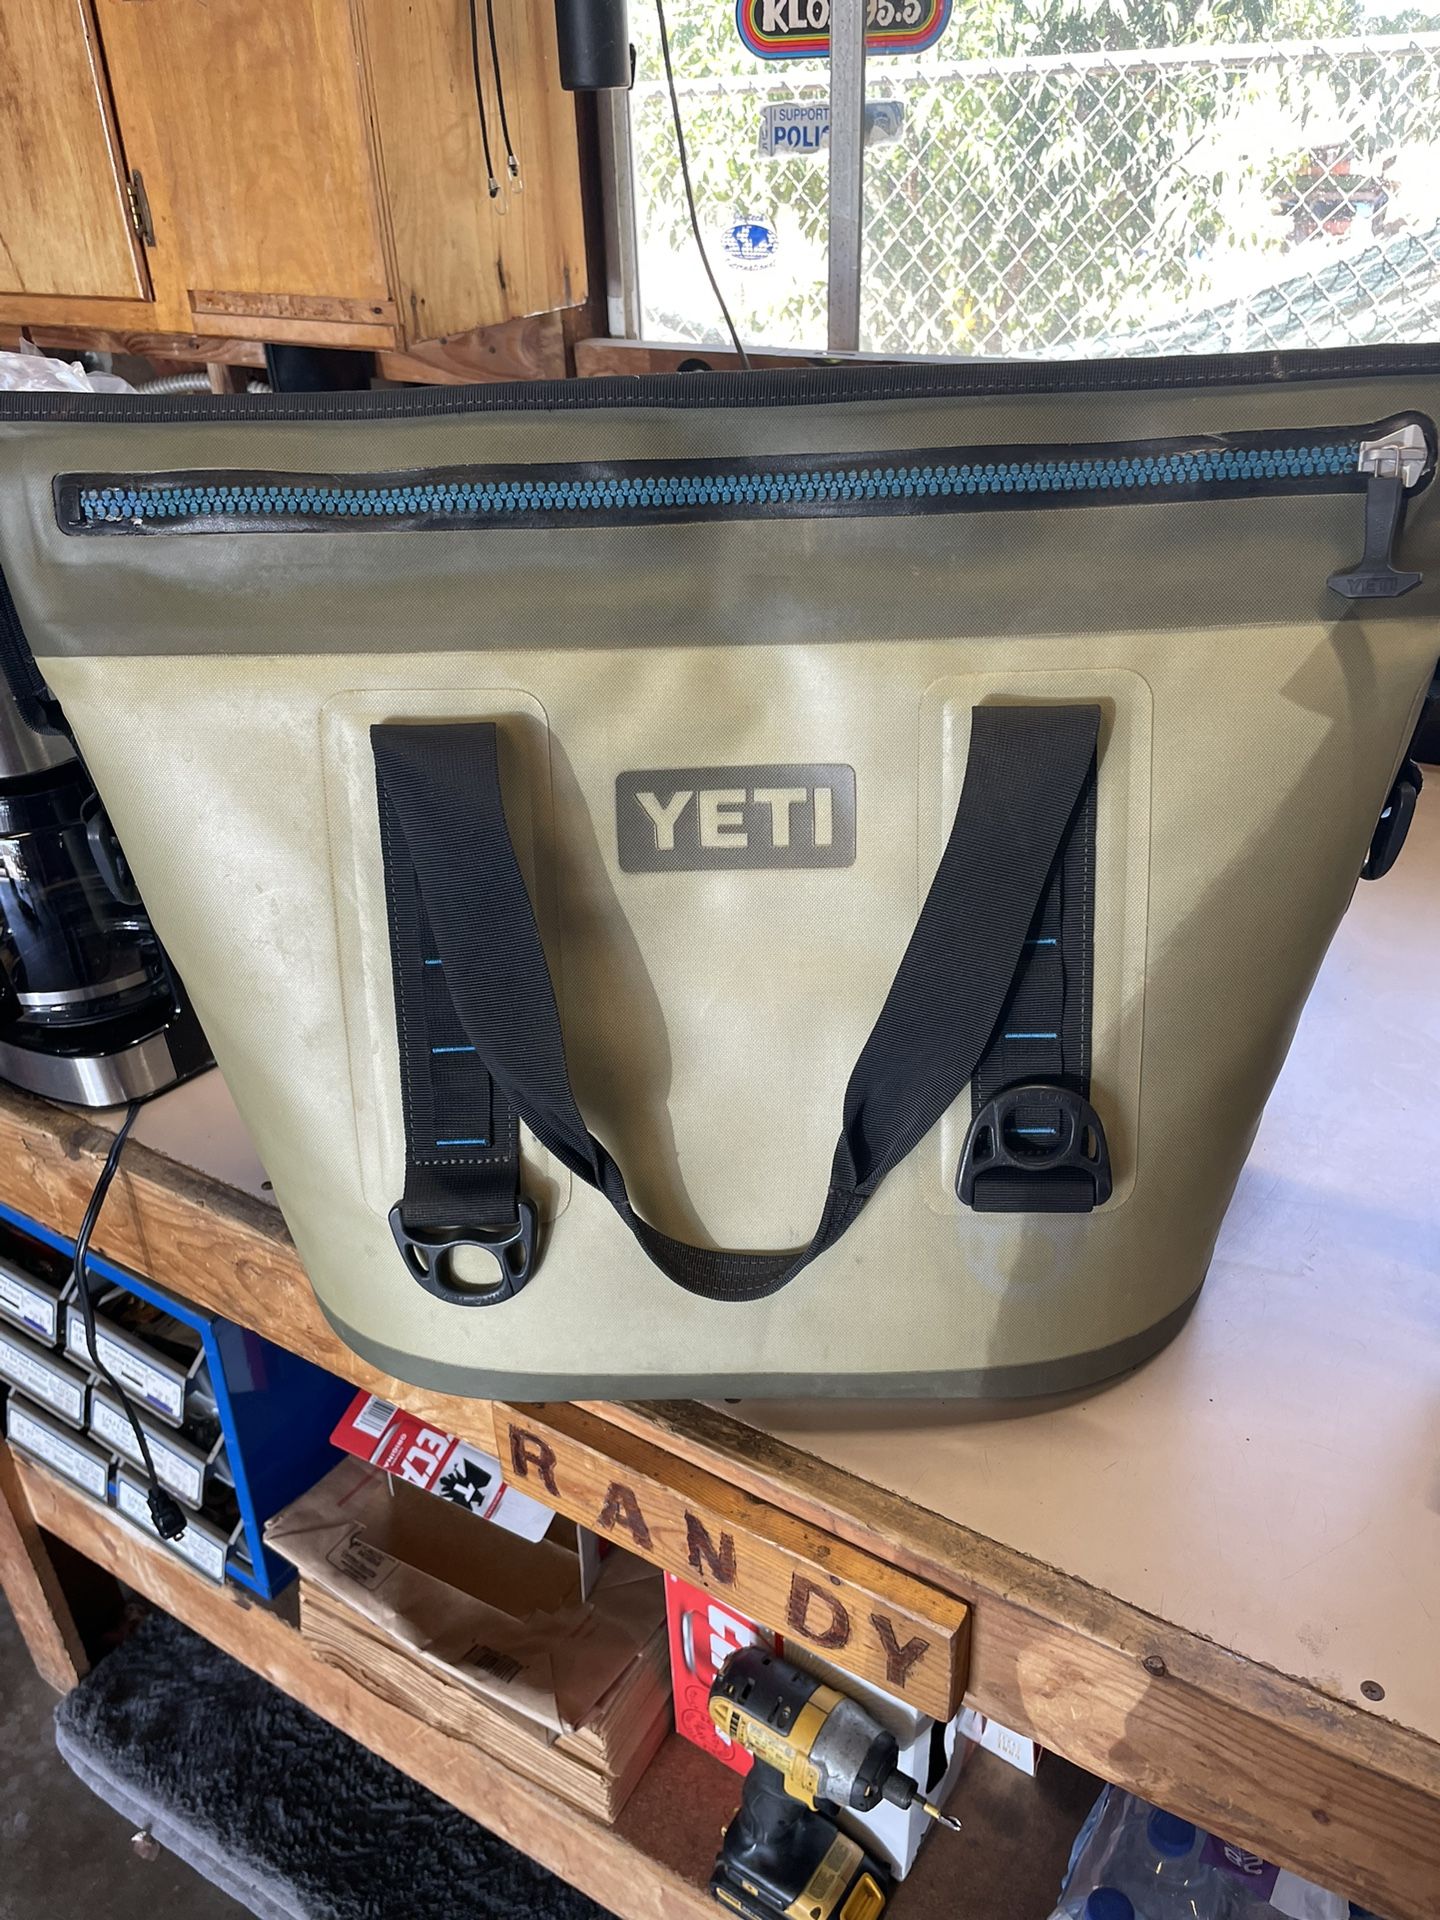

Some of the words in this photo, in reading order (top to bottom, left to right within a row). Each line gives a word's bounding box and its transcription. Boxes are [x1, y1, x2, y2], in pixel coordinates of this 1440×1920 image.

[763, 0, 830, 33] KLO
[779, 108, 830, 121] SUPPORT
[1346, 577, 1398, 595] YETI
[634, 787, 832, 850] YETI
[398, 1428, 455, 1489] ECA
[508, 1423, 931, 1689] RANDY
